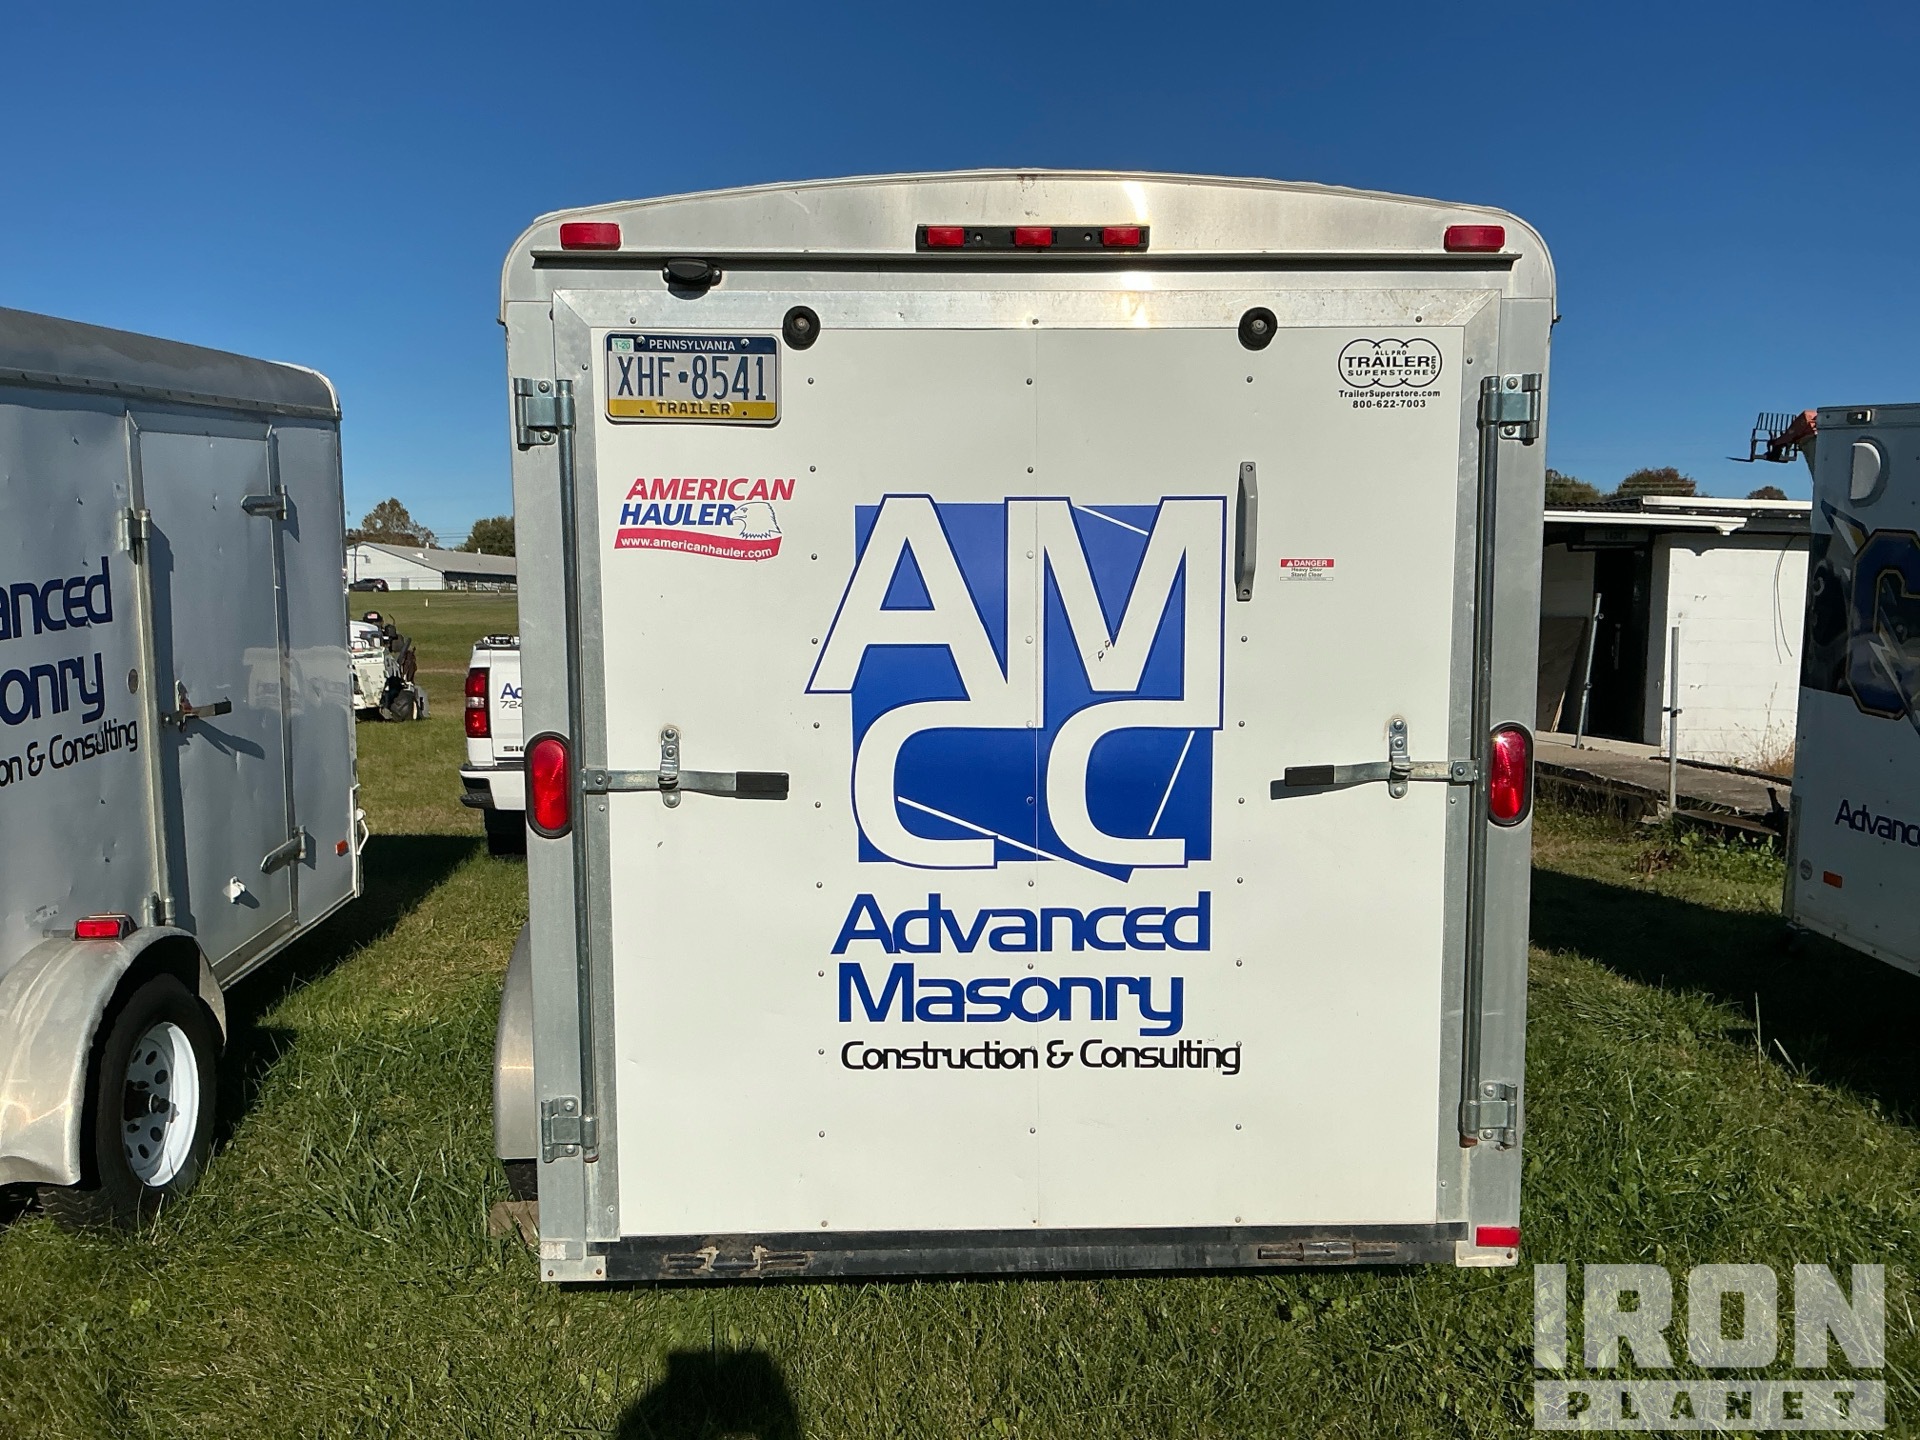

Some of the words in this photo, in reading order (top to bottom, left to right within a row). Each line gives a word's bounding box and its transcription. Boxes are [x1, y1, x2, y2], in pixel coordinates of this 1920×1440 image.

[649, 339, 736, 351] PENNSYLVANIA
[1345, 356, 1430, 368] TRAILER
[1338, 390, 1441, 399] TrailerSuperstore.com
[1352, 400, 1426, 408] 800-622-7003
[656, 402, 731, 415] TRAILER
[625, 478, 796, 501] AMERICAN
[619, 503, 736, 526] HAULER
[620, 537, 773, 559] www.americanhauler.com
[27, 741, 45, 777] &
[49, 718, 138, 769] Consulting
[830, 891, 1211, 955] Advanced
[838, 962, 1184, 1036] Masonry
[841, 1040, 1038, 1070] Construction
[1046, 1039, 1074, 1068] &
[1079, 1038, 1241, 1076] Consulting
